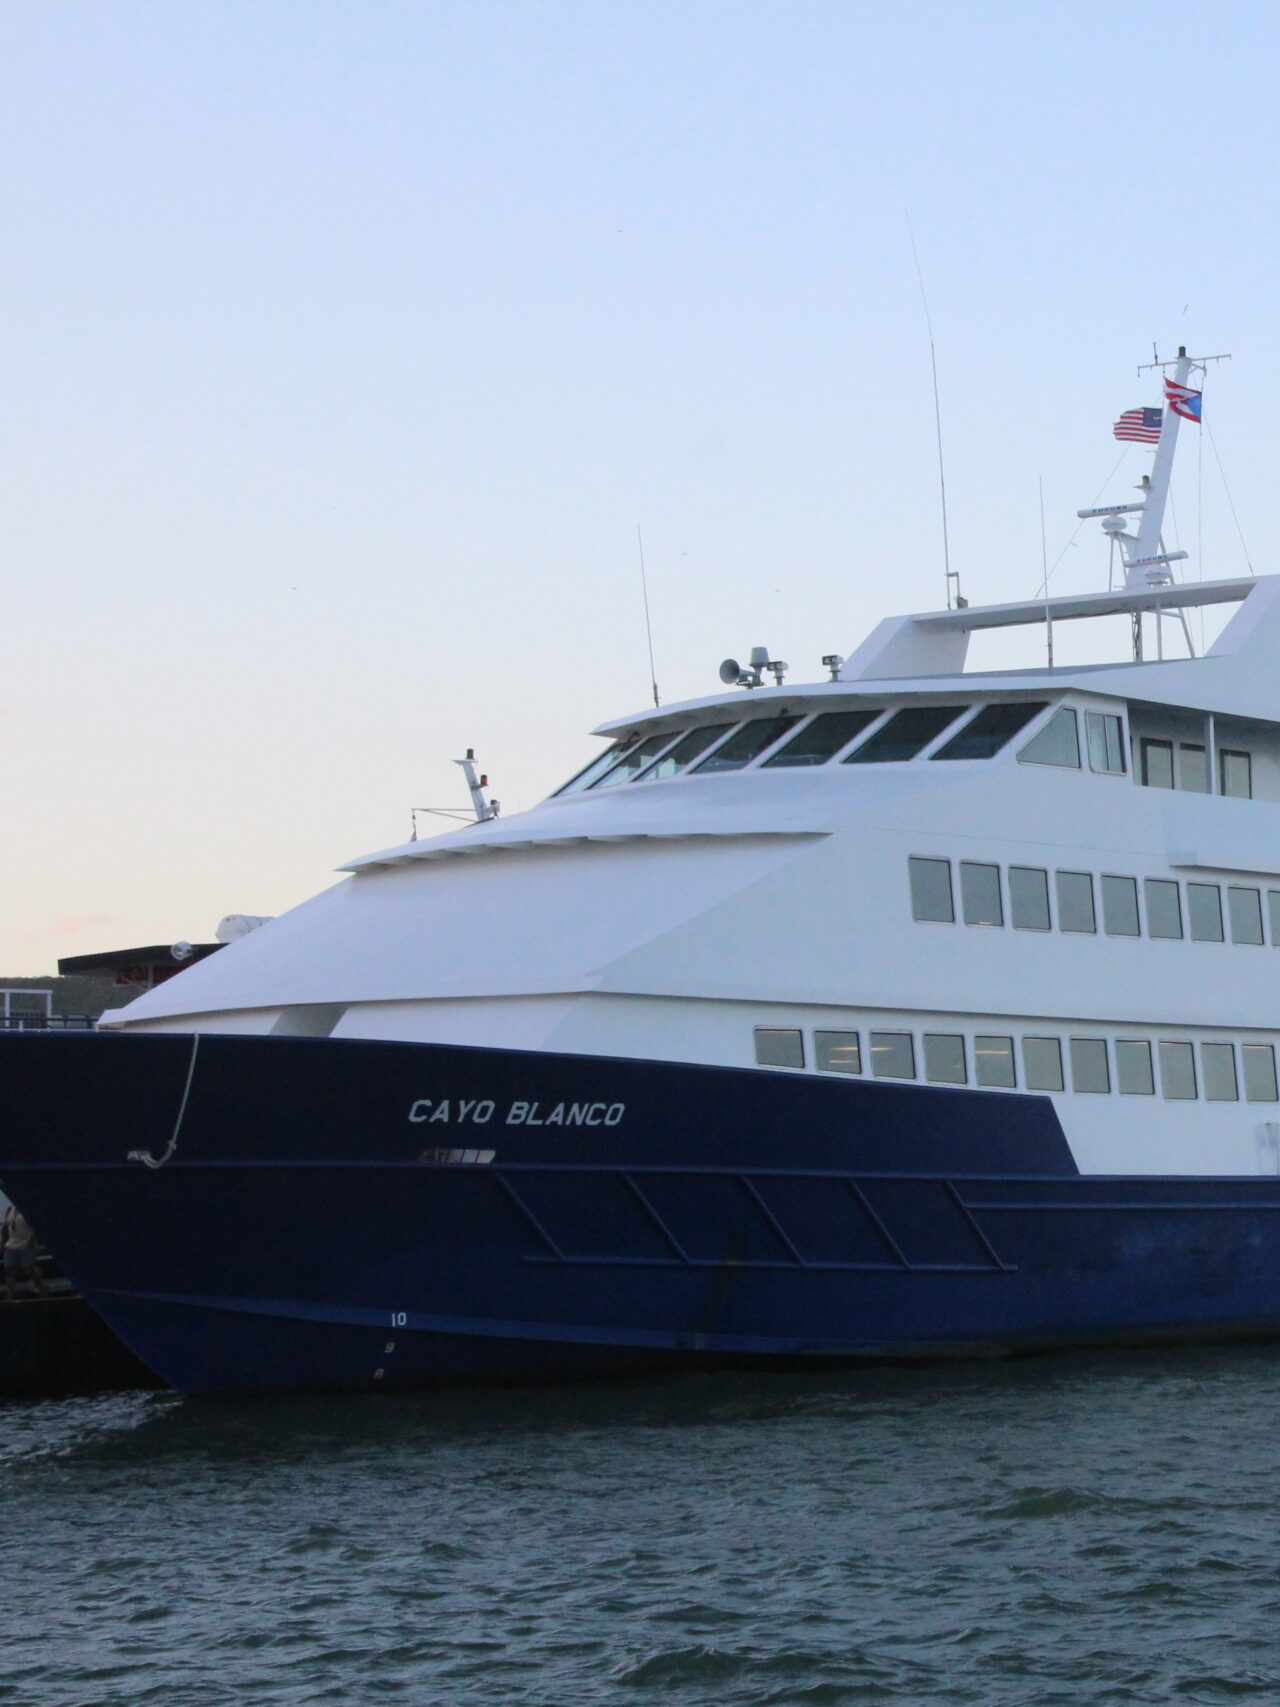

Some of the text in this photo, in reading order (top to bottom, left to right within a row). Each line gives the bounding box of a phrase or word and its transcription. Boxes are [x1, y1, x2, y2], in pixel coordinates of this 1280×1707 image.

[408, 1099, 626, 1127] CAYO BLANCO
[391, 1312, 407, 1327] 10
[384, 1342, 395, 1353] 9
